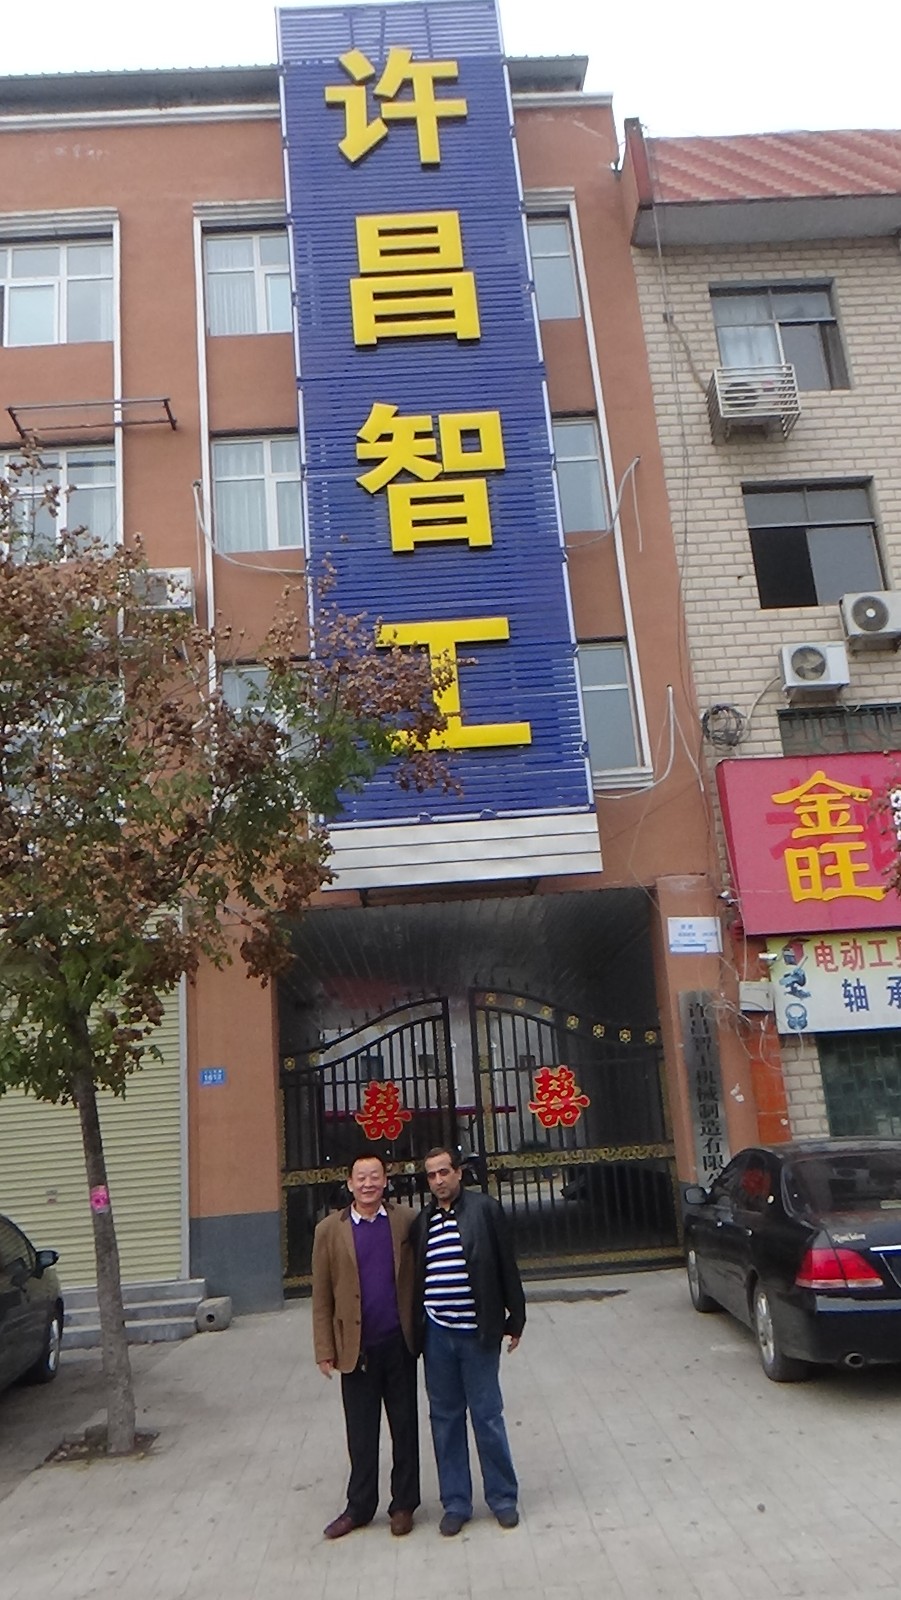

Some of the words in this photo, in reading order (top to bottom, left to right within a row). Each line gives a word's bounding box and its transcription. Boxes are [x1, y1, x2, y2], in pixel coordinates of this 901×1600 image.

[324, 45, 533, 752] 许昌智工
[771, 770, 887, 902] 金旺
[814, 936, 901, 972] 电动工
